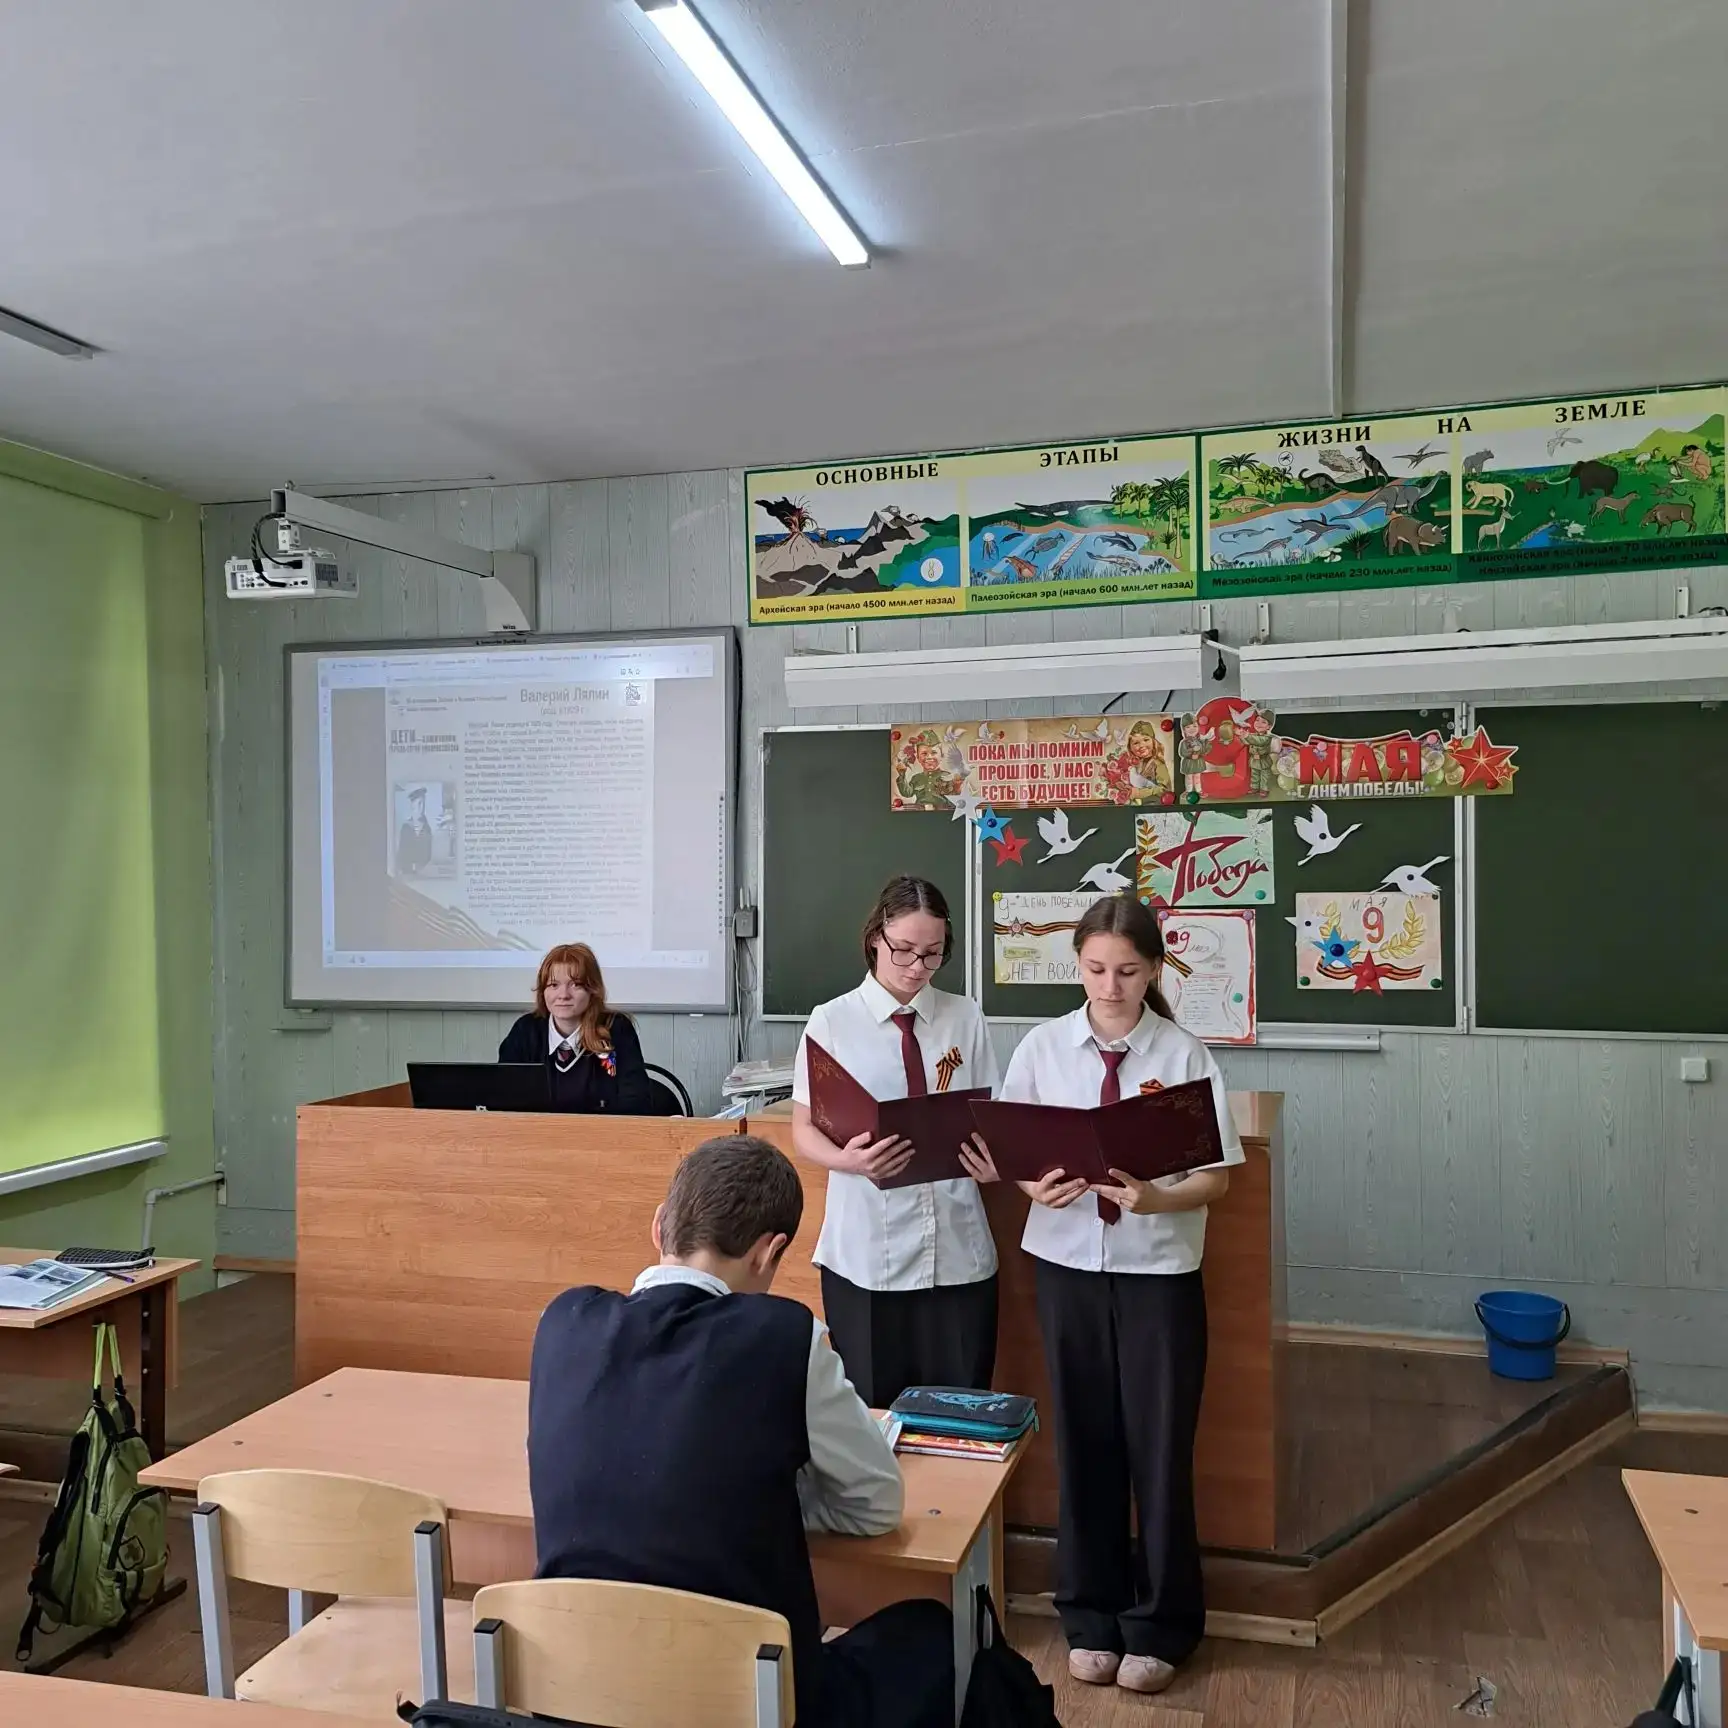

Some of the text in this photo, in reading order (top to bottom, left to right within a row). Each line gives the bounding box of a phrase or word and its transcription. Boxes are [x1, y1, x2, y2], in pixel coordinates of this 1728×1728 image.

[816, 400, 1646, 486] ОСНОВНЫЕ ЭТАПЫ ЖИЗНИ НА ЗЕМЛЕ
[1349, 568, 1370, 578] 230
[971, 591, 1038, 602] Палеозойская
[1040, 589, 1057, 600] эра
[1059, 587, 1096, 598] (начало
[1099, 584, 1118, 593] 600
[1161, 579, 1194, 590] назад)
[759, 605, 805, 615] Архейская
[808, 604, 824, 613] эра
[826, 602, 860, 612] (начало
[862, 599, 886, 609] 4500
[925, 596, 956, 605] назад)
[520, 688, 570, 704] Валерий
[573, 687, 609, 701] Лялин
[969, 741, 1103, 760] ПОКА МЫ ПОМНИМ
[1197, 697, 1257, 799] 9
[1053, 763, 1062, 778] У
[1064, 761, 1094, 778] НАС
[1299, 740, 1422, 784] МАЯ
[982, 782, 1091, 802] ЕСТЬ БУДУЩЕЕ!
[1297, 781, 1424, 799] С ДНЕМ ПОБЕДЫ!
[1152, 836, 1269, 906] Победа
[1019, 897, 1047, 908] ДЕНЬ
[1350, 896, 1388, 910] МАЯ
[1362, 907, 1385, 943] 9
[1172, 931, 1190, 954] 9
[1012, 962, 1041, 981] НЕТ
